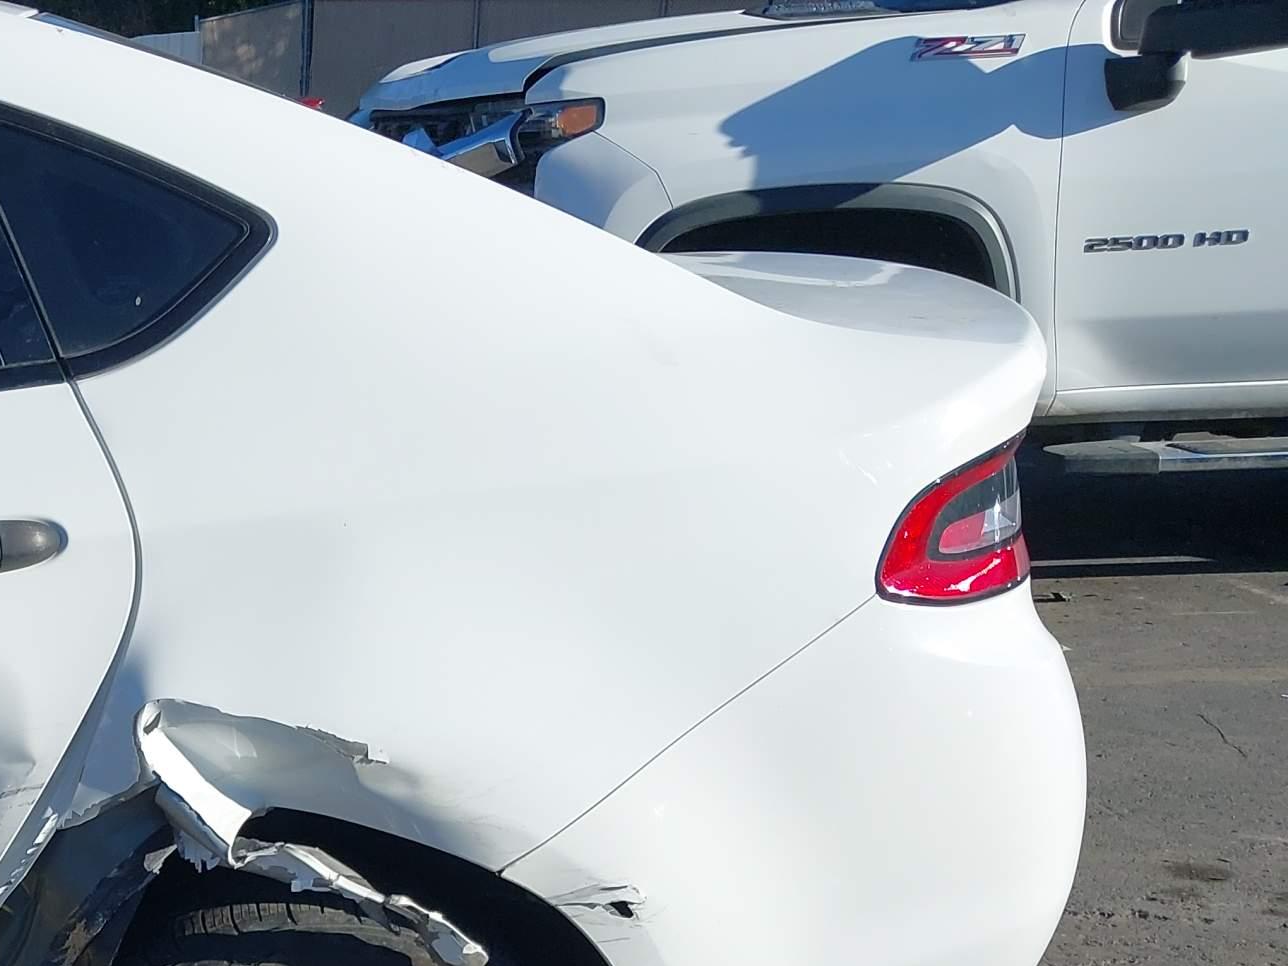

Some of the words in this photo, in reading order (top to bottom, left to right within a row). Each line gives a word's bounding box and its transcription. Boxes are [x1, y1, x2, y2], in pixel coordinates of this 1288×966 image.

[912, 33, 1026, 60] Z71
[1083, 233, 1185, 253] 2500
[1193, 229, 1249, 248] HD
